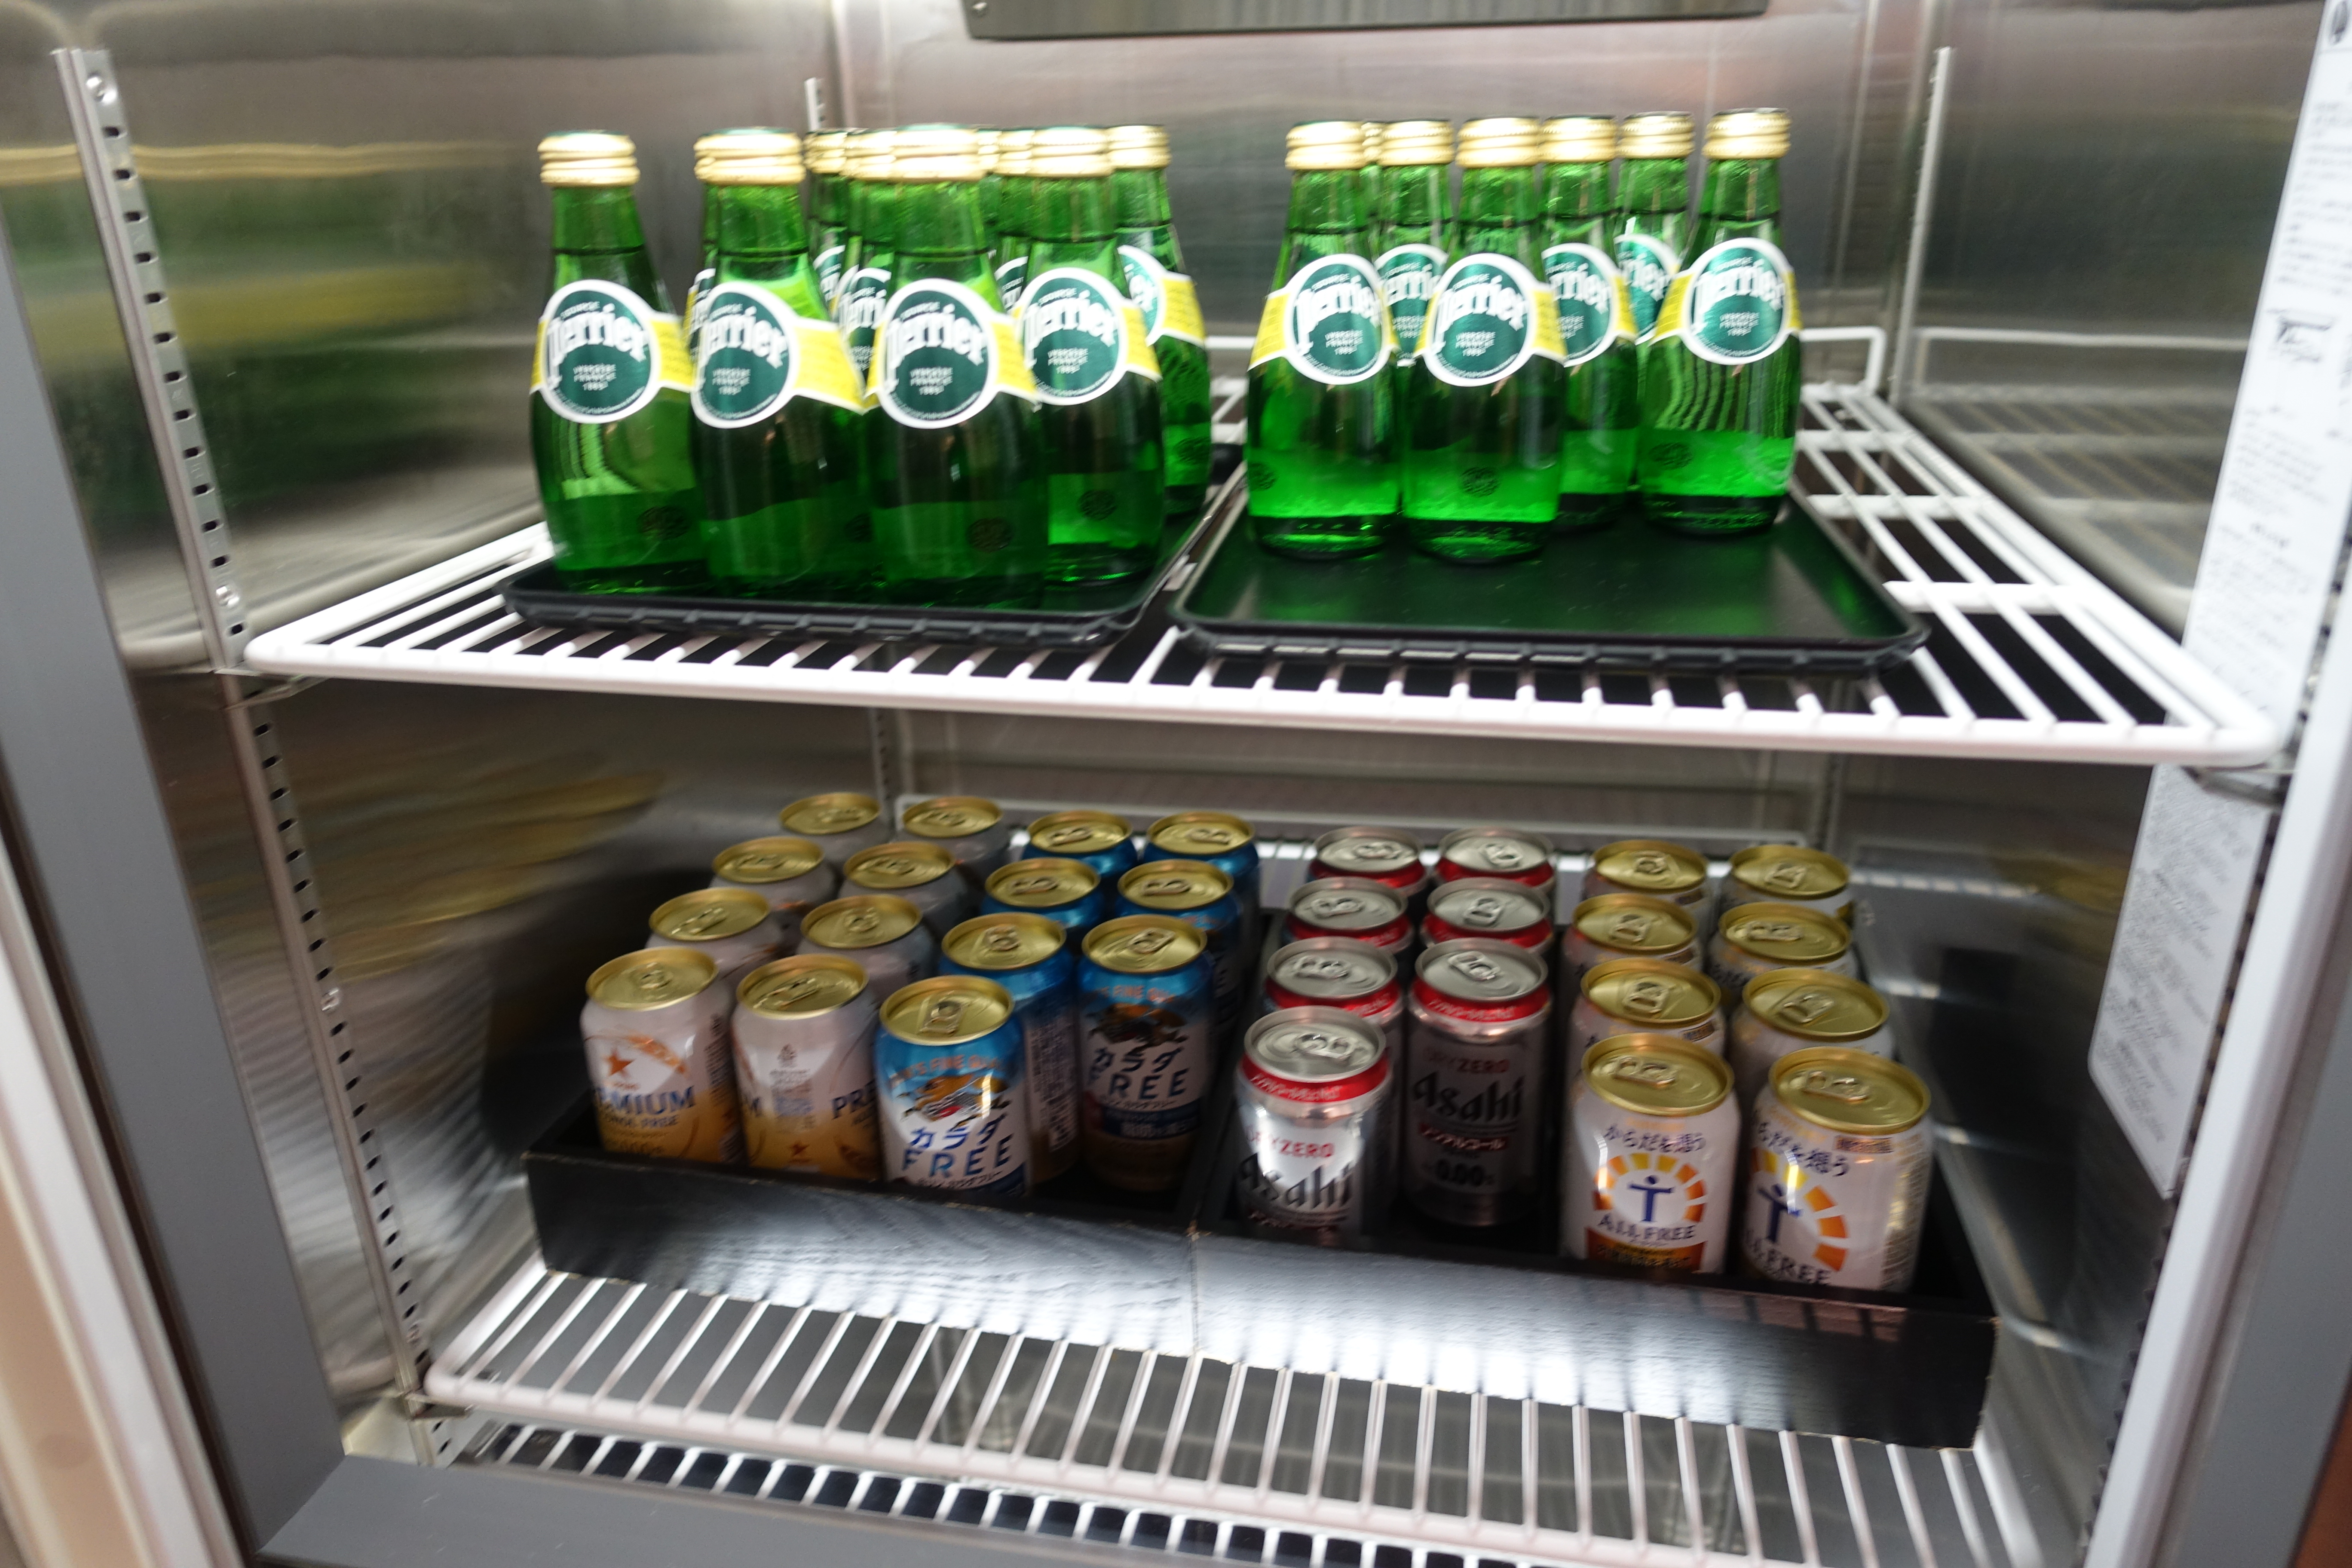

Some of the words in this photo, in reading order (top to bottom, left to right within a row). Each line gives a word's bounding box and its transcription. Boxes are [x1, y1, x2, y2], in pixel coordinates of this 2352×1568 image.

[1295, 275, 1382, 357] Perrier
[1432, 275, 1528, 356] Perrier
[1550, 263, 1612, 315] rrier
[1690, 259, 1785, 336] Perrier
[547, 303, 649, 390] Perrier
[885, 303, 987, 395] Perrier
[1023, 290, 1119, 371] Perrier
[1094, 1047, 1185, 1073] カラダ
[1413, 1071, 1525, 1121] Asahi
[901, 1133, 1014, 1179] FREE
[909, 1113, 1008, 1151] カラダ
[1238, 1152, 1353, 1209] Asahi
